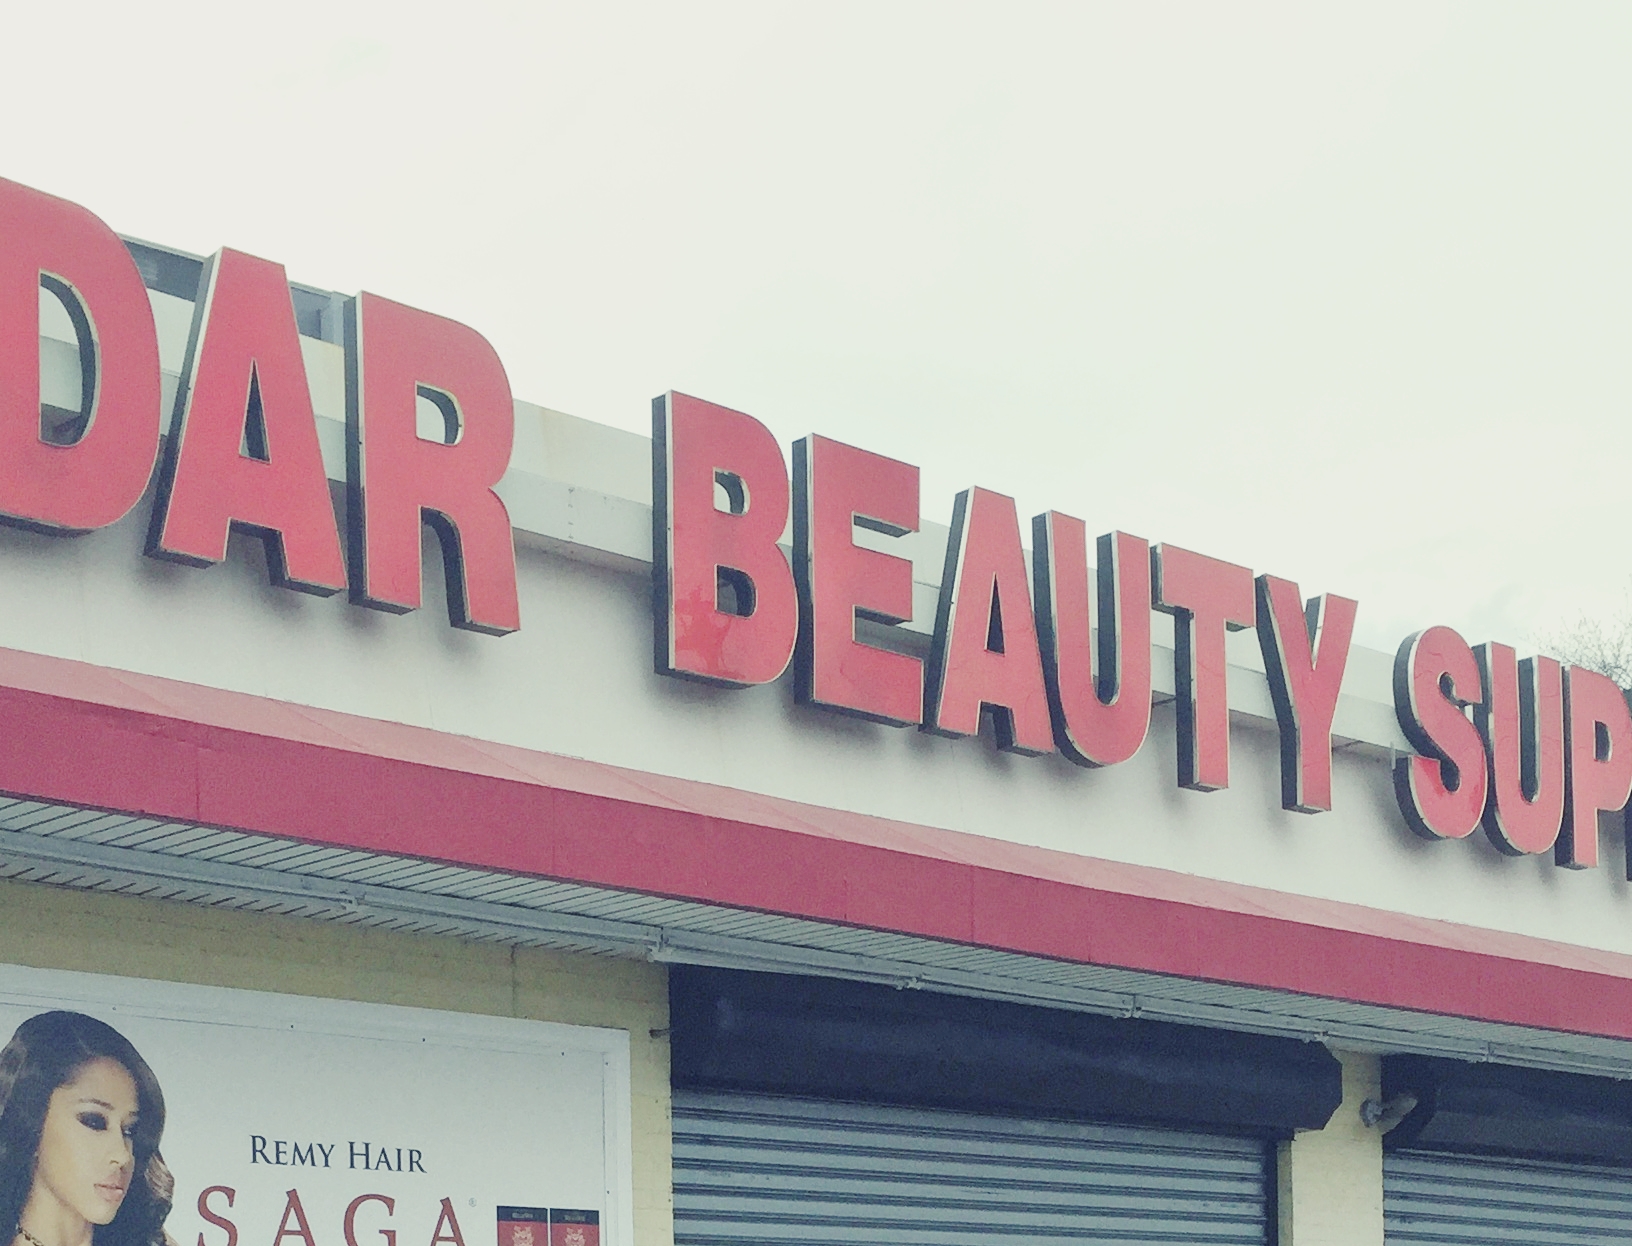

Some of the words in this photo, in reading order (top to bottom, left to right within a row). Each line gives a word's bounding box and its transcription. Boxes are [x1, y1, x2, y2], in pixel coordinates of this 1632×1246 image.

[0, 177, 520, 637] DAR
[652, 390, 1358, 814] BEAUTY
[1393, 625, 1632, 881] SUP
[250, 1134, 335, 1168] REMY
[348, 1141, 427, 1173] HAIR
